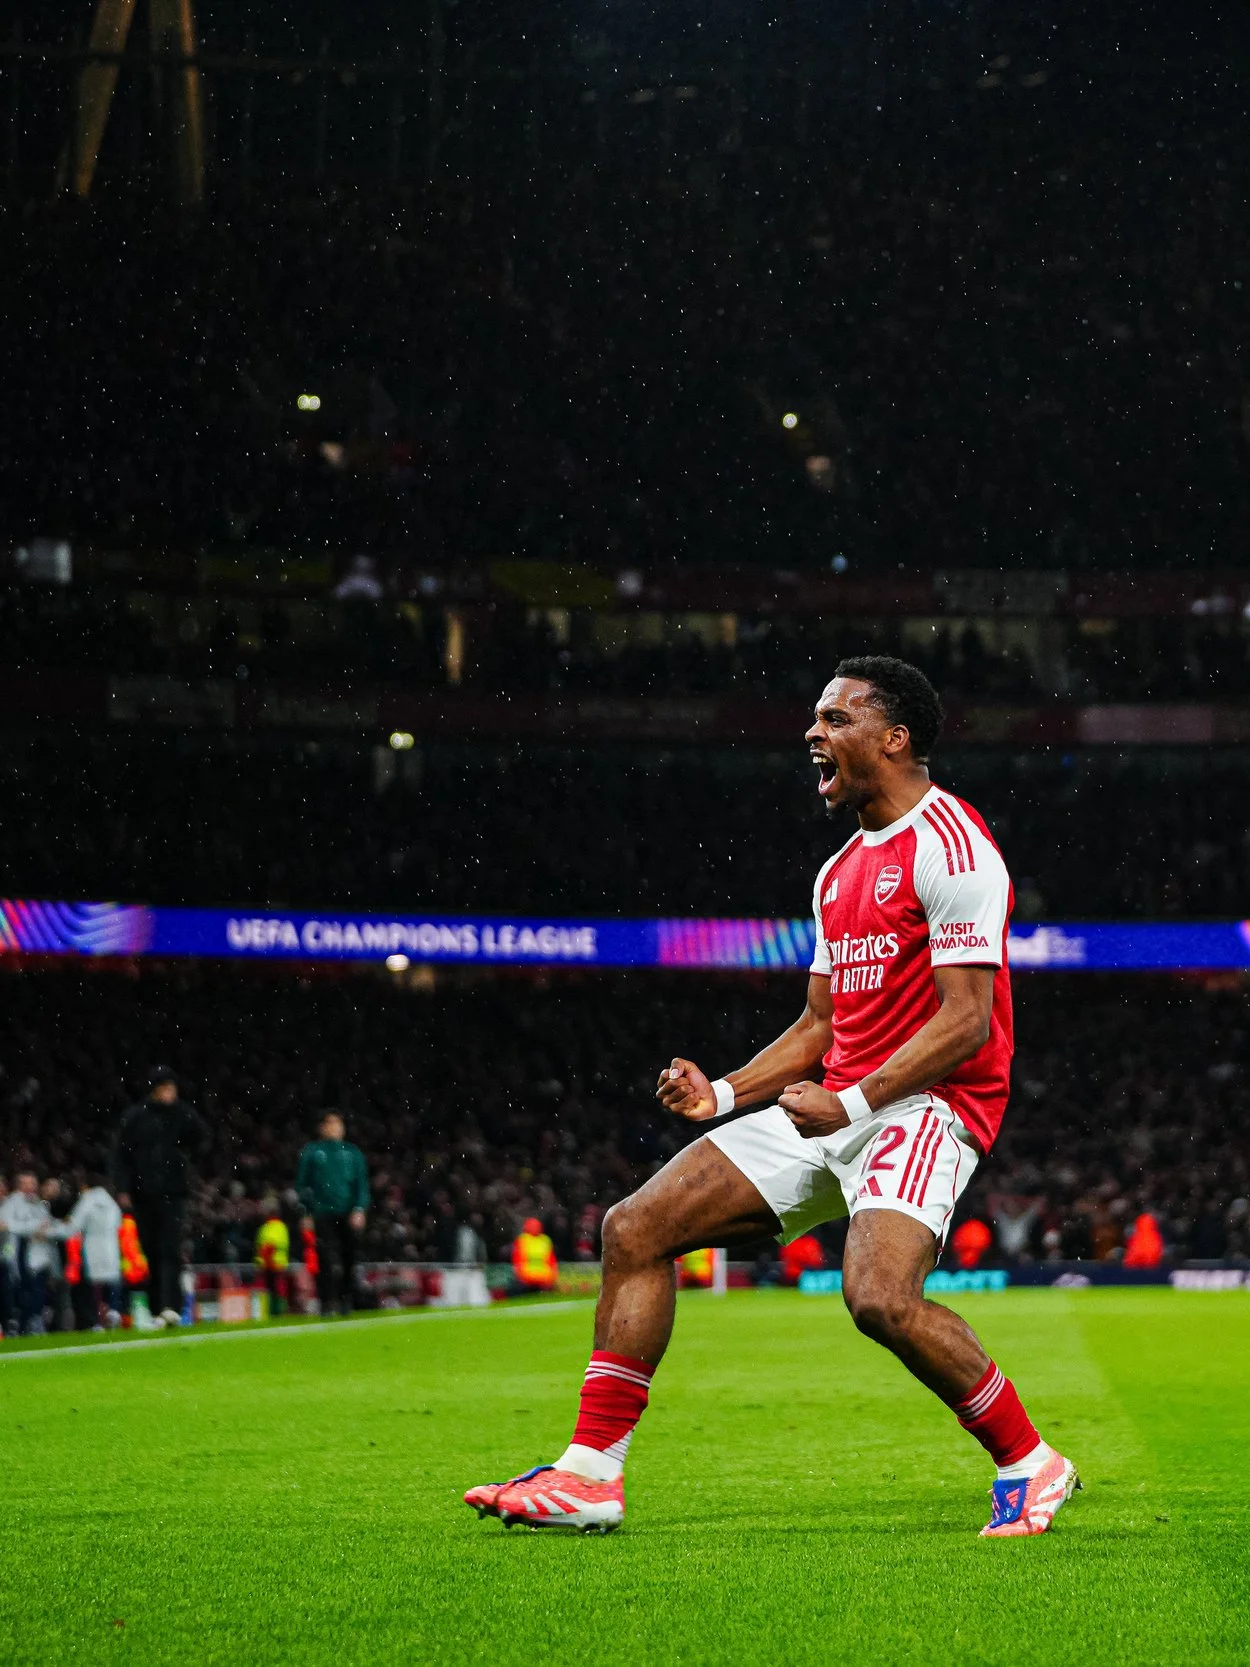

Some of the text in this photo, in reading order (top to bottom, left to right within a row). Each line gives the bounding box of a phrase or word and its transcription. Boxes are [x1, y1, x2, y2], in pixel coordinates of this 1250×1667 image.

[226, 918, 597, 960] UEFA CHAMPIONS LEAGUE
[929, 935, 989, 951] RWANDA
[939, 922, 975, 935] VISIT
[825, 931, 900, 967] mirates
[842, 964, 884, 993] BETTER
